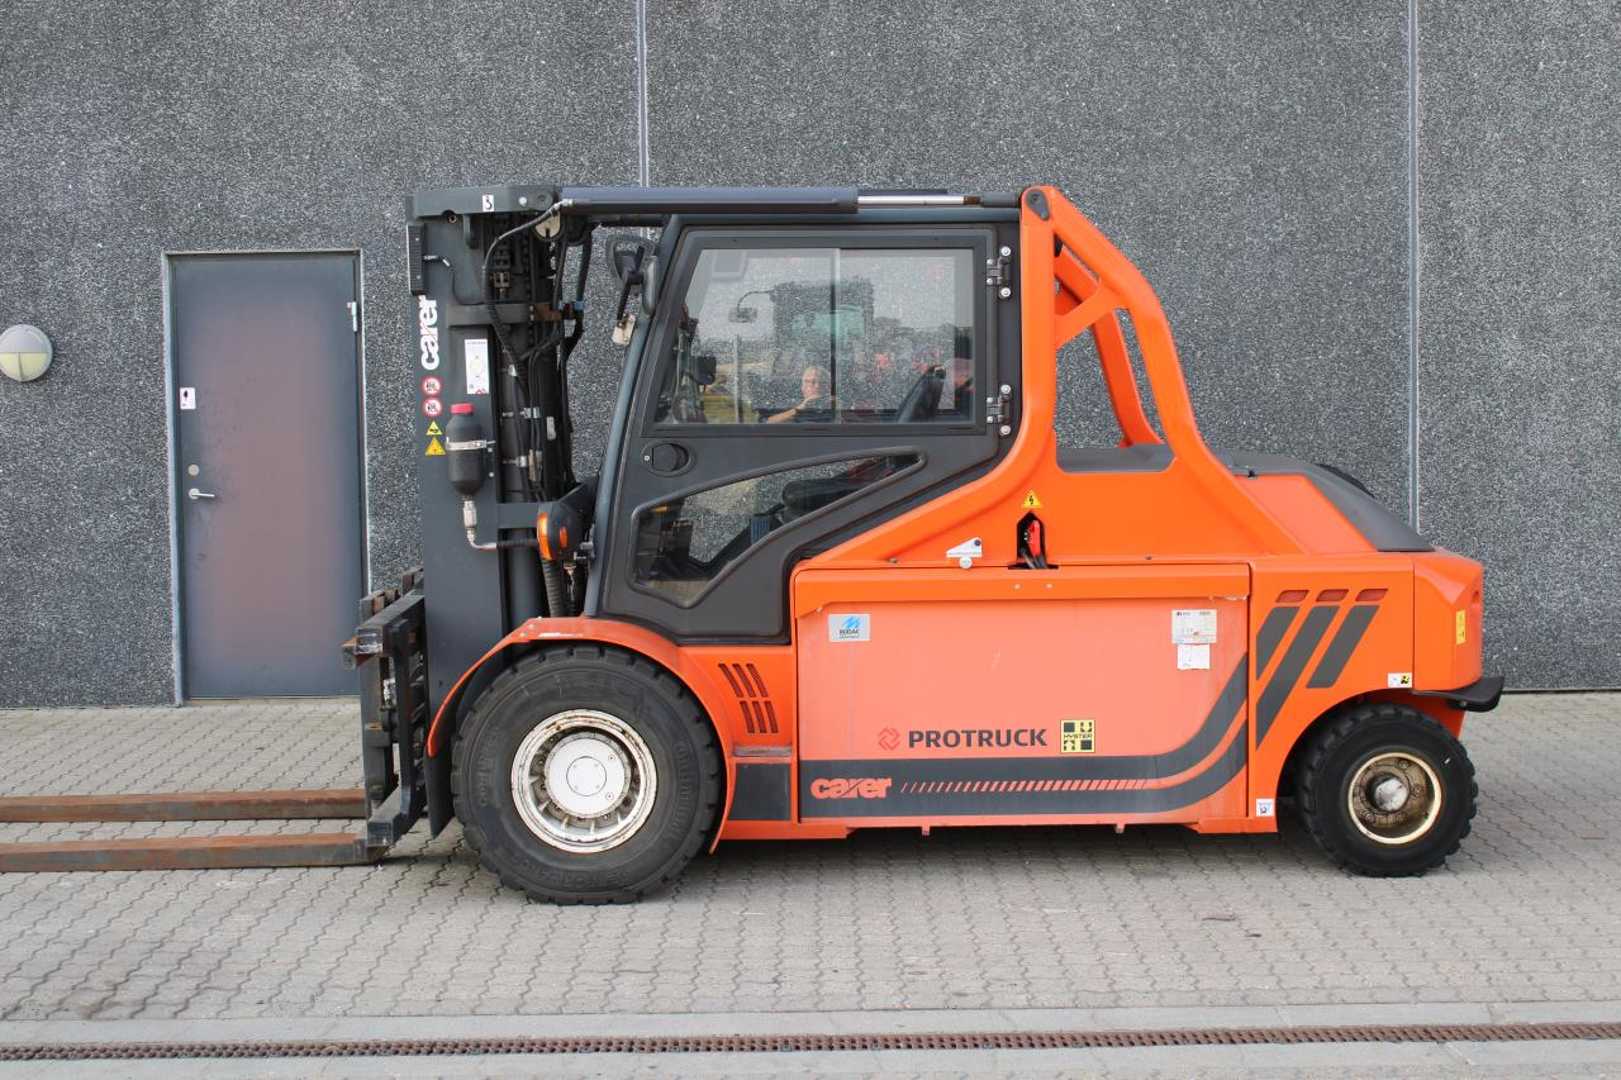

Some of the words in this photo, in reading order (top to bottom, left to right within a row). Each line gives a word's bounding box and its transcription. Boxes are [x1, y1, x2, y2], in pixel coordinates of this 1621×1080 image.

[418, 294, 439, 370] carer
[908, 729, 1047, 748] PROTRUCK
[810, 777, 892, 799] carer
